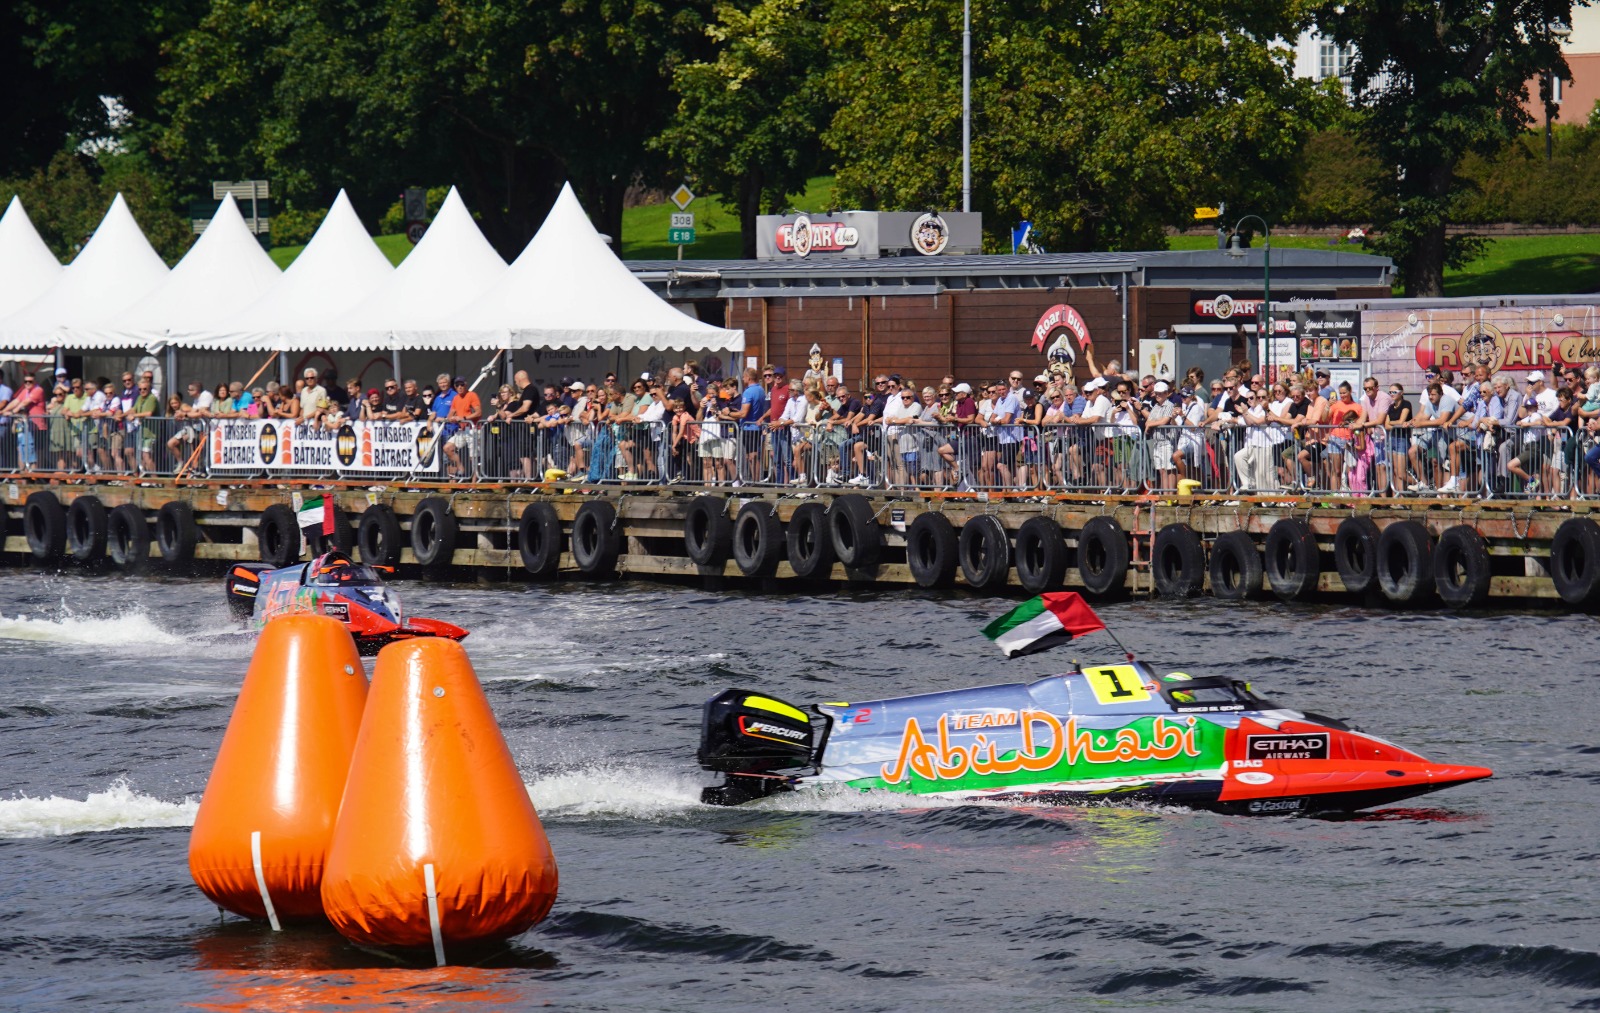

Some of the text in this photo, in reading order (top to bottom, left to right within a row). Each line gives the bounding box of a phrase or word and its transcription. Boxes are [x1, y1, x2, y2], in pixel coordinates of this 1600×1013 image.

[673, 216, 691, 225] 308
[1036, 311, 1060, 341] Roar
[1067, 310, 1085, 340] bua
[1100, 669, 1133, 698] 1
[842, 708, 873, 723] F2
[952, 712, 1017, 729] TEAM
[746, 721, 808, 740] MERCURY
[1253, 738, 1324, 751] ETIHAD
[1265, 751, 1311, 759] AIRWAYS
[1262, 800, 1302, 811] Castrol
